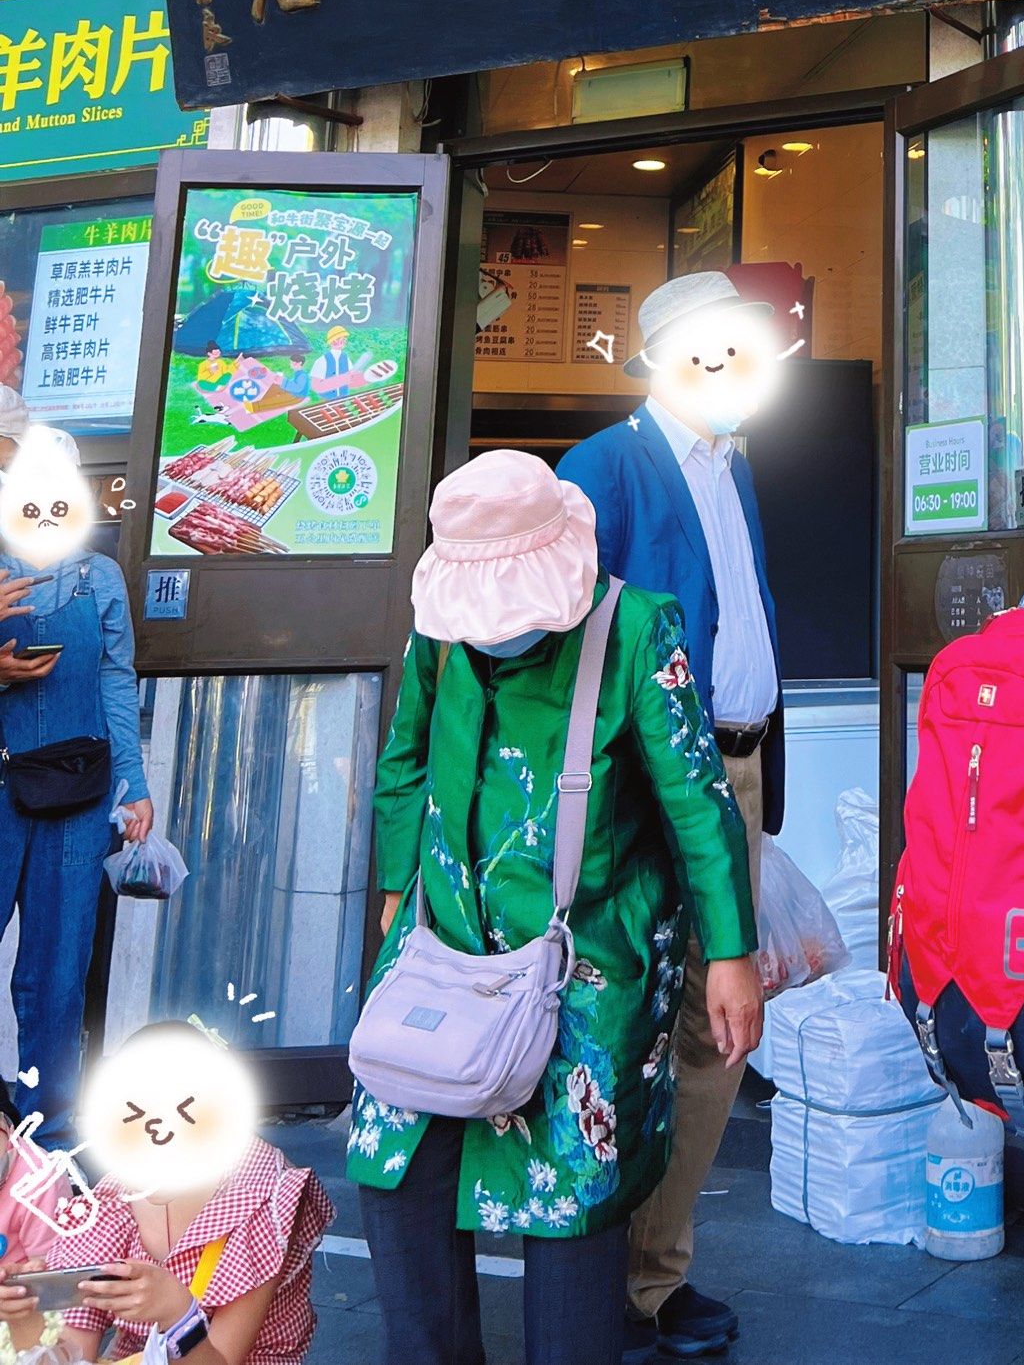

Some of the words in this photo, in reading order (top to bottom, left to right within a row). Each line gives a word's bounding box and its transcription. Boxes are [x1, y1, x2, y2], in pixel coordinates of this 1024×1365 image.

[25, 114, 76, 131] Mutton
[82, 105, 123, 123] Slices
[241, 202, 264, 210] GOOD
[241, 210, 264, 218] TIME!
[51, 256, 133, 282] 草原羔羊肉片
[47, 284, 116, 308] 精选肥牛片
[267, 271, 375, 323] 烧烤
[44, 312, 100, 335] 鲜牛百叶
[41, 338, 110, 362] 高钙羊肉片
[38, 365, 108, 388] 上脑肥牛片
[919, 449, 971, 476] 营业时间
[914, 494, 941, 512] 06:30
[951, 491, 977, 509] 19:00
[155, 576, 181, 603] 推
[153, 606, 179, 614] PUSH
